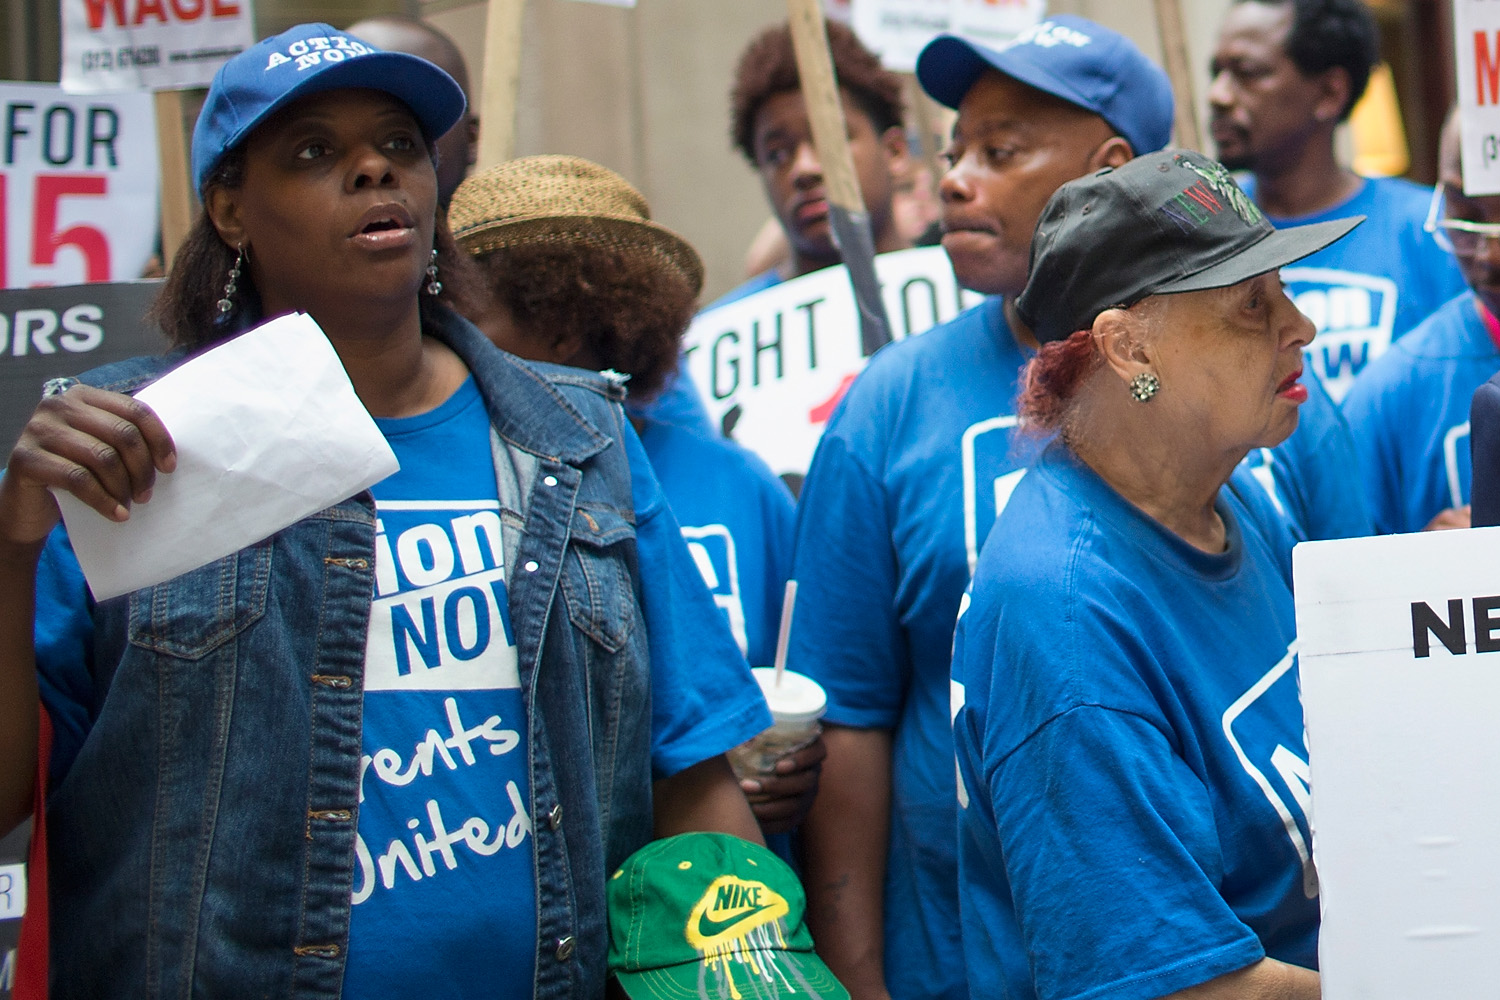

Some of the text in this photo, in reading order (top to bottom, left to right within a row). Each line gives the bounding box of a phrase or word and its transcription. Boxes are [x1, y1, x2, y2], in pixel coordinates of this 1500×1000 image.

[6, 104, 119, 168] FOR
[391, 580, 517, 678] NO
[712, 882, 762, 912] NIKE
